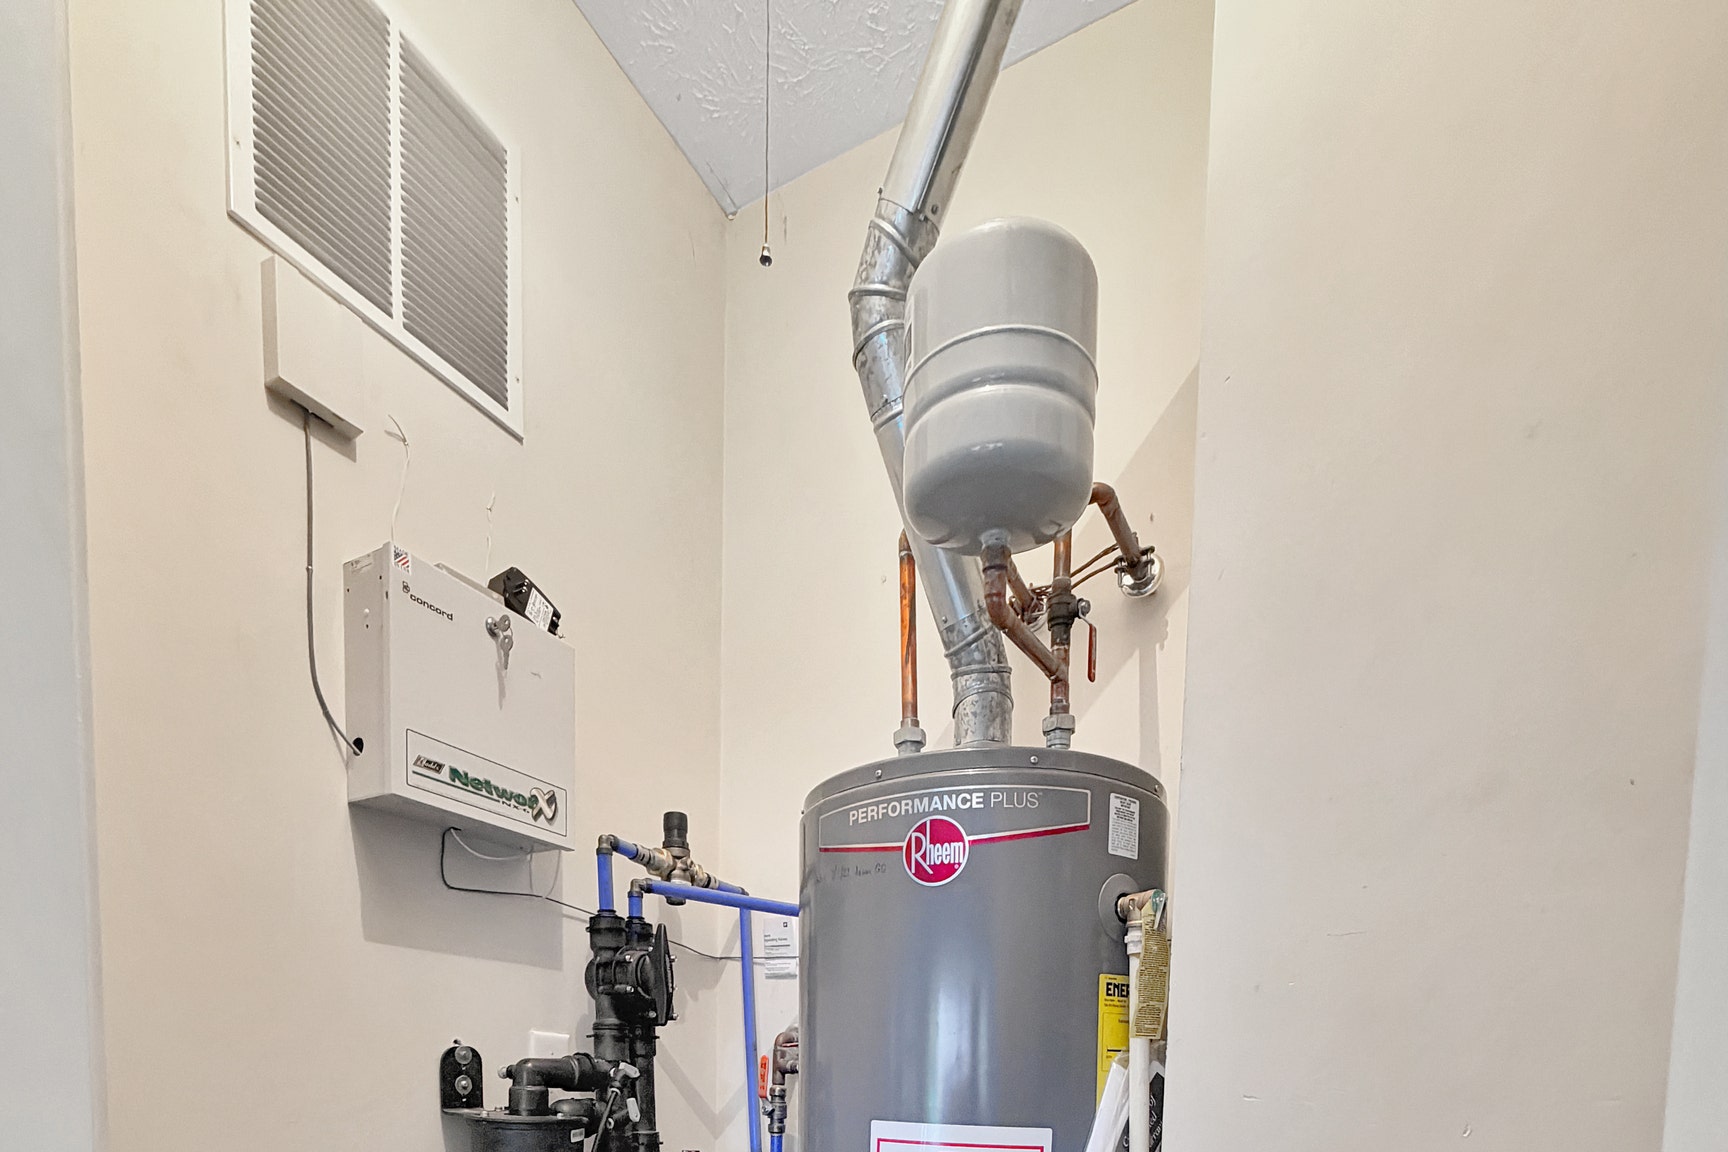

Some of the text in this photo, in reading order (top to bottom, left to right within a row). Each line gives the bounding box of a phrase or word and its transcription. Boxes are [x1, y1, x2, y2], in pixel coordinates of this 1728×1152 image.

[409, 594, 453, 621] concord
[849, 792, 984, 826] PERFORMANCE
[910, 819, 964, 875] Rheem
